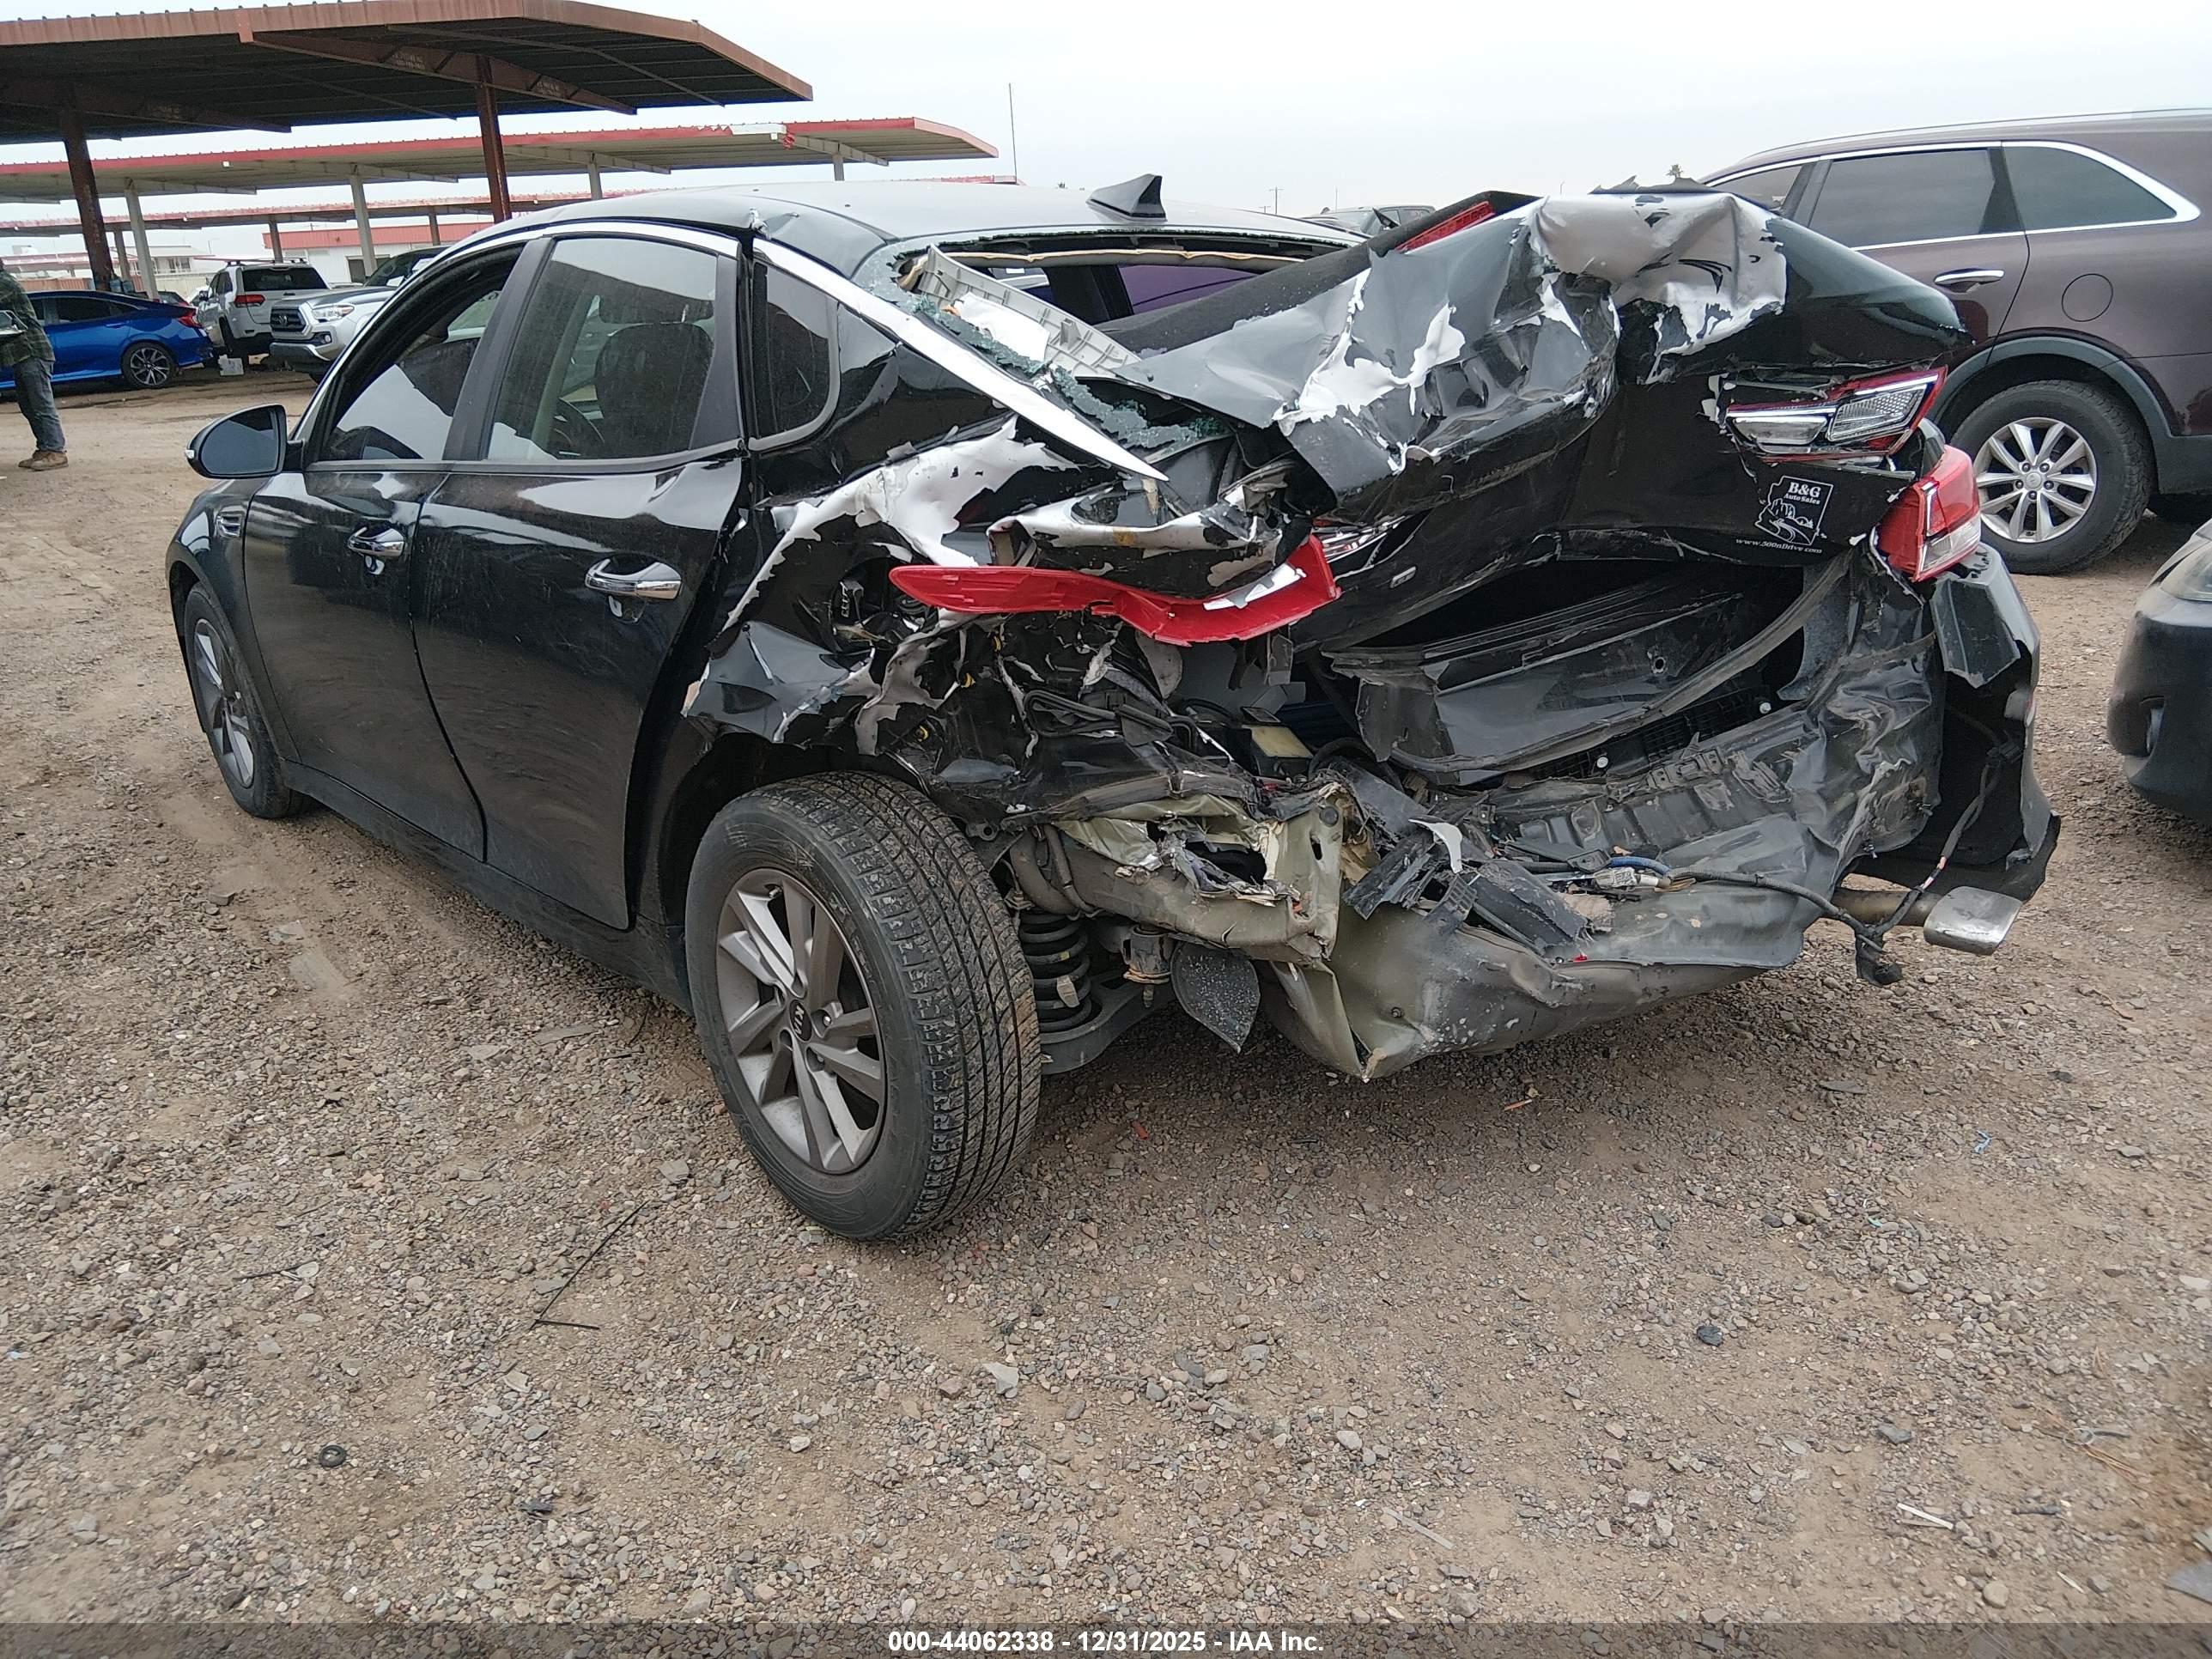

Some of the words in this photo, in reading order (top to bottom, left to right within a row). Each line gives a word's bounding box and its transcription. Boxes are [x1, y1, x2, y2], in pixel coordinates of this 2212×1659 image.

[1788, 482, 1821, 498] B&G
[1784, 493, 1802, 501] Auto
[1801, 496, 1821, 505] Sales
[793, 1005, 805, 1035] KIA
